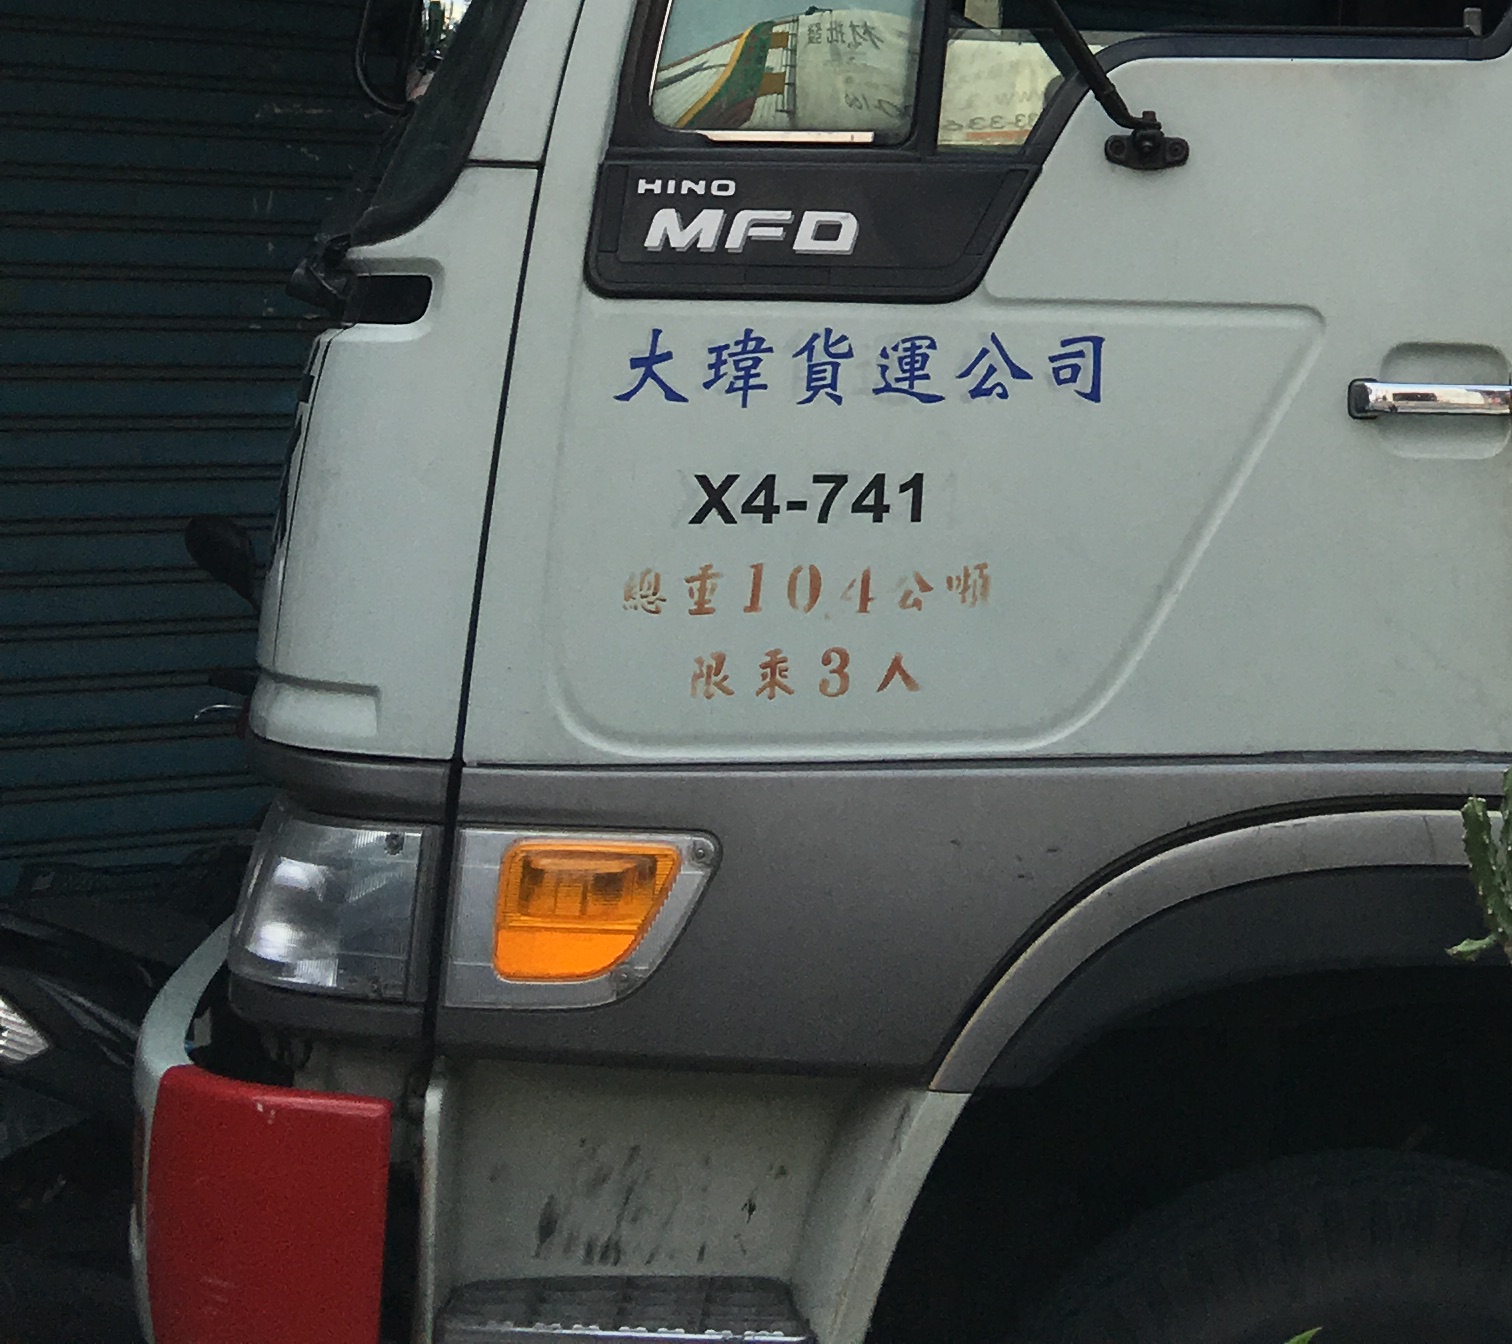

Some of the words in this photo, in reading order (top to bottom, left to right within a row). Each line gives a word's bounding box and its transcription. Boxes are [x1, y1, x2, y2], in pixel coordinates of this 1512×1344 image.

[637, 178, 737, 197] HINO
[643, 208, 860, 255] MFD
[613, 327, 1107, 409] 大瑋貨運公司
[688, 472, 926, 525] X4-741
